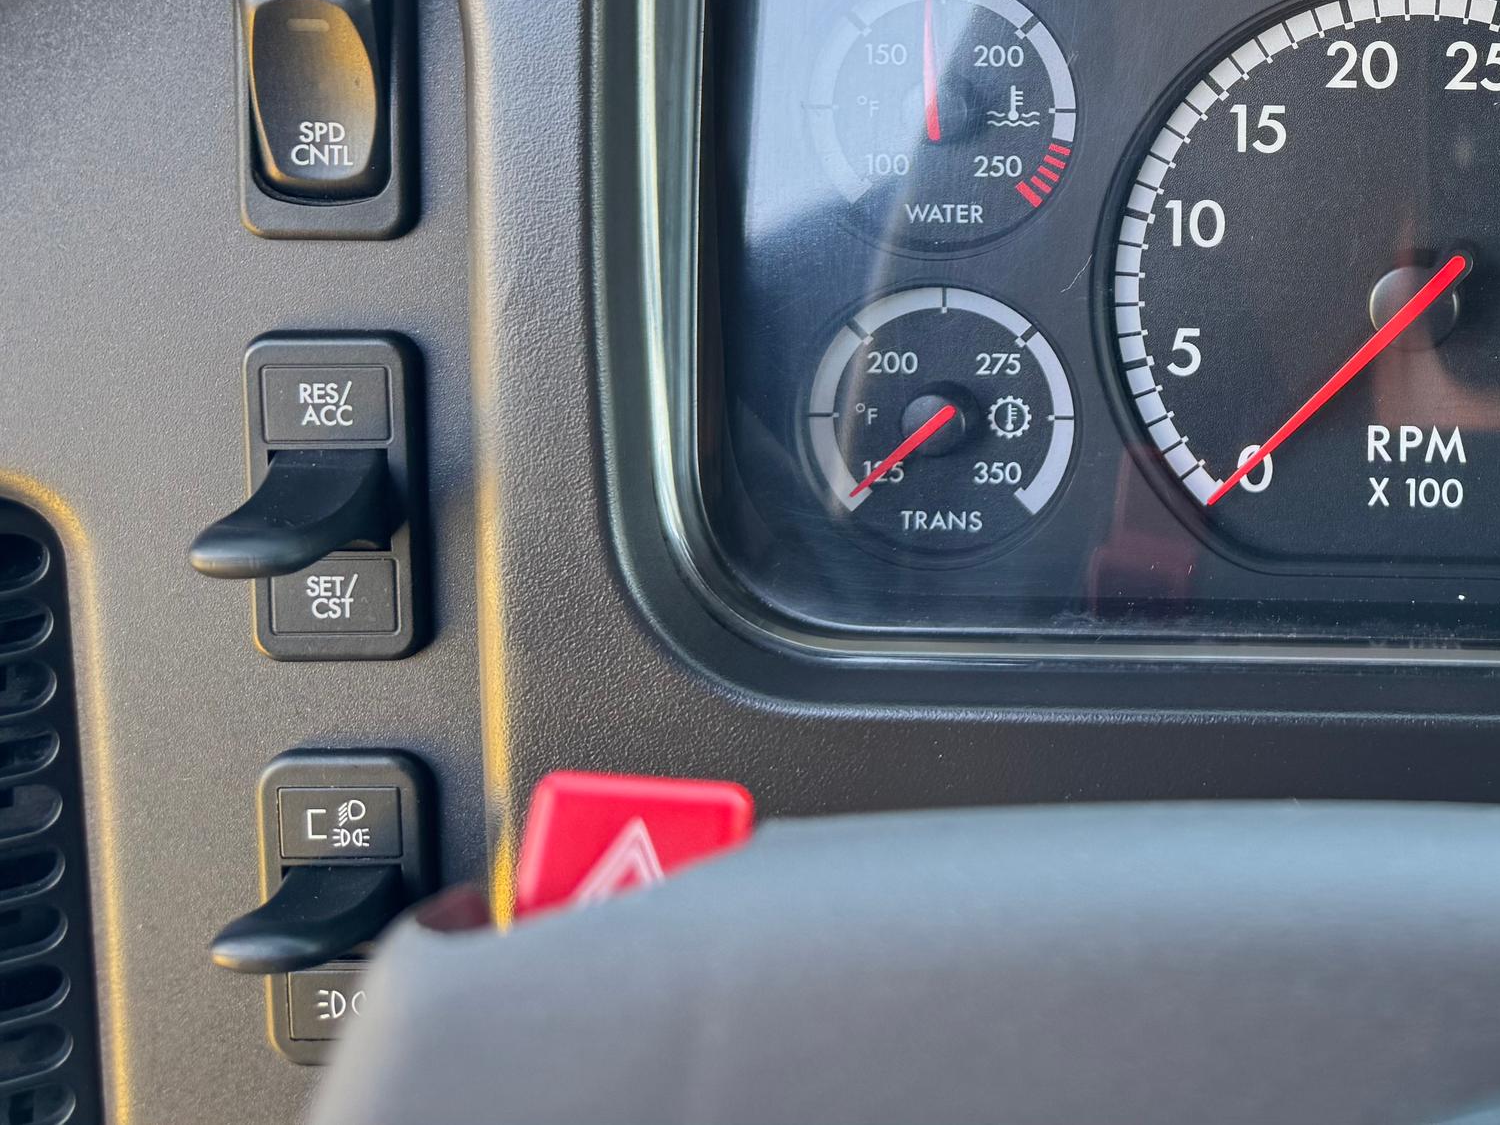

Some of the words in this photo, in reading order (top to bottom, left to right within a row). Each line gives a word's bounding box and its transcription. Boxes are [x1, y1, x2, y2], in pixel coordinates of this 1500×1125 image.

[865, 43, 907, 65] 150
[973, 45, 1024, 67] 200
[1325, 41, 1398, 90] 20
[299, 121, 345, 143] SPD
[1230, 104, 1286, 154] 15
[291, 144, 353, 166] CNTL
[866, 154, 909, 175] 100
[973, 156, 1023, 178] 250
[905, 204, 984, 225] WATER
[1165, 200, 1225, 248] 10
[867, 352, 918, 374] 200
[1167, 328, 1202, 377] 5
[976, 353, 1022, 375] 275
[300, 381, 352, 405] RES/
[302, 405, 353, 426] ACC
[1367, 425, 1467, 463] RPM
[973, 462, 1022, 484] 350
[1237, 445, 1273, 492] 0
[1368, 478, 1389, 506] X
[1406, 478, 1464, 508] 100
[901, 510, 983, 531] TRANS
[306, 574, 358, 598] SET/
[311, 598, 354, 619] CST
